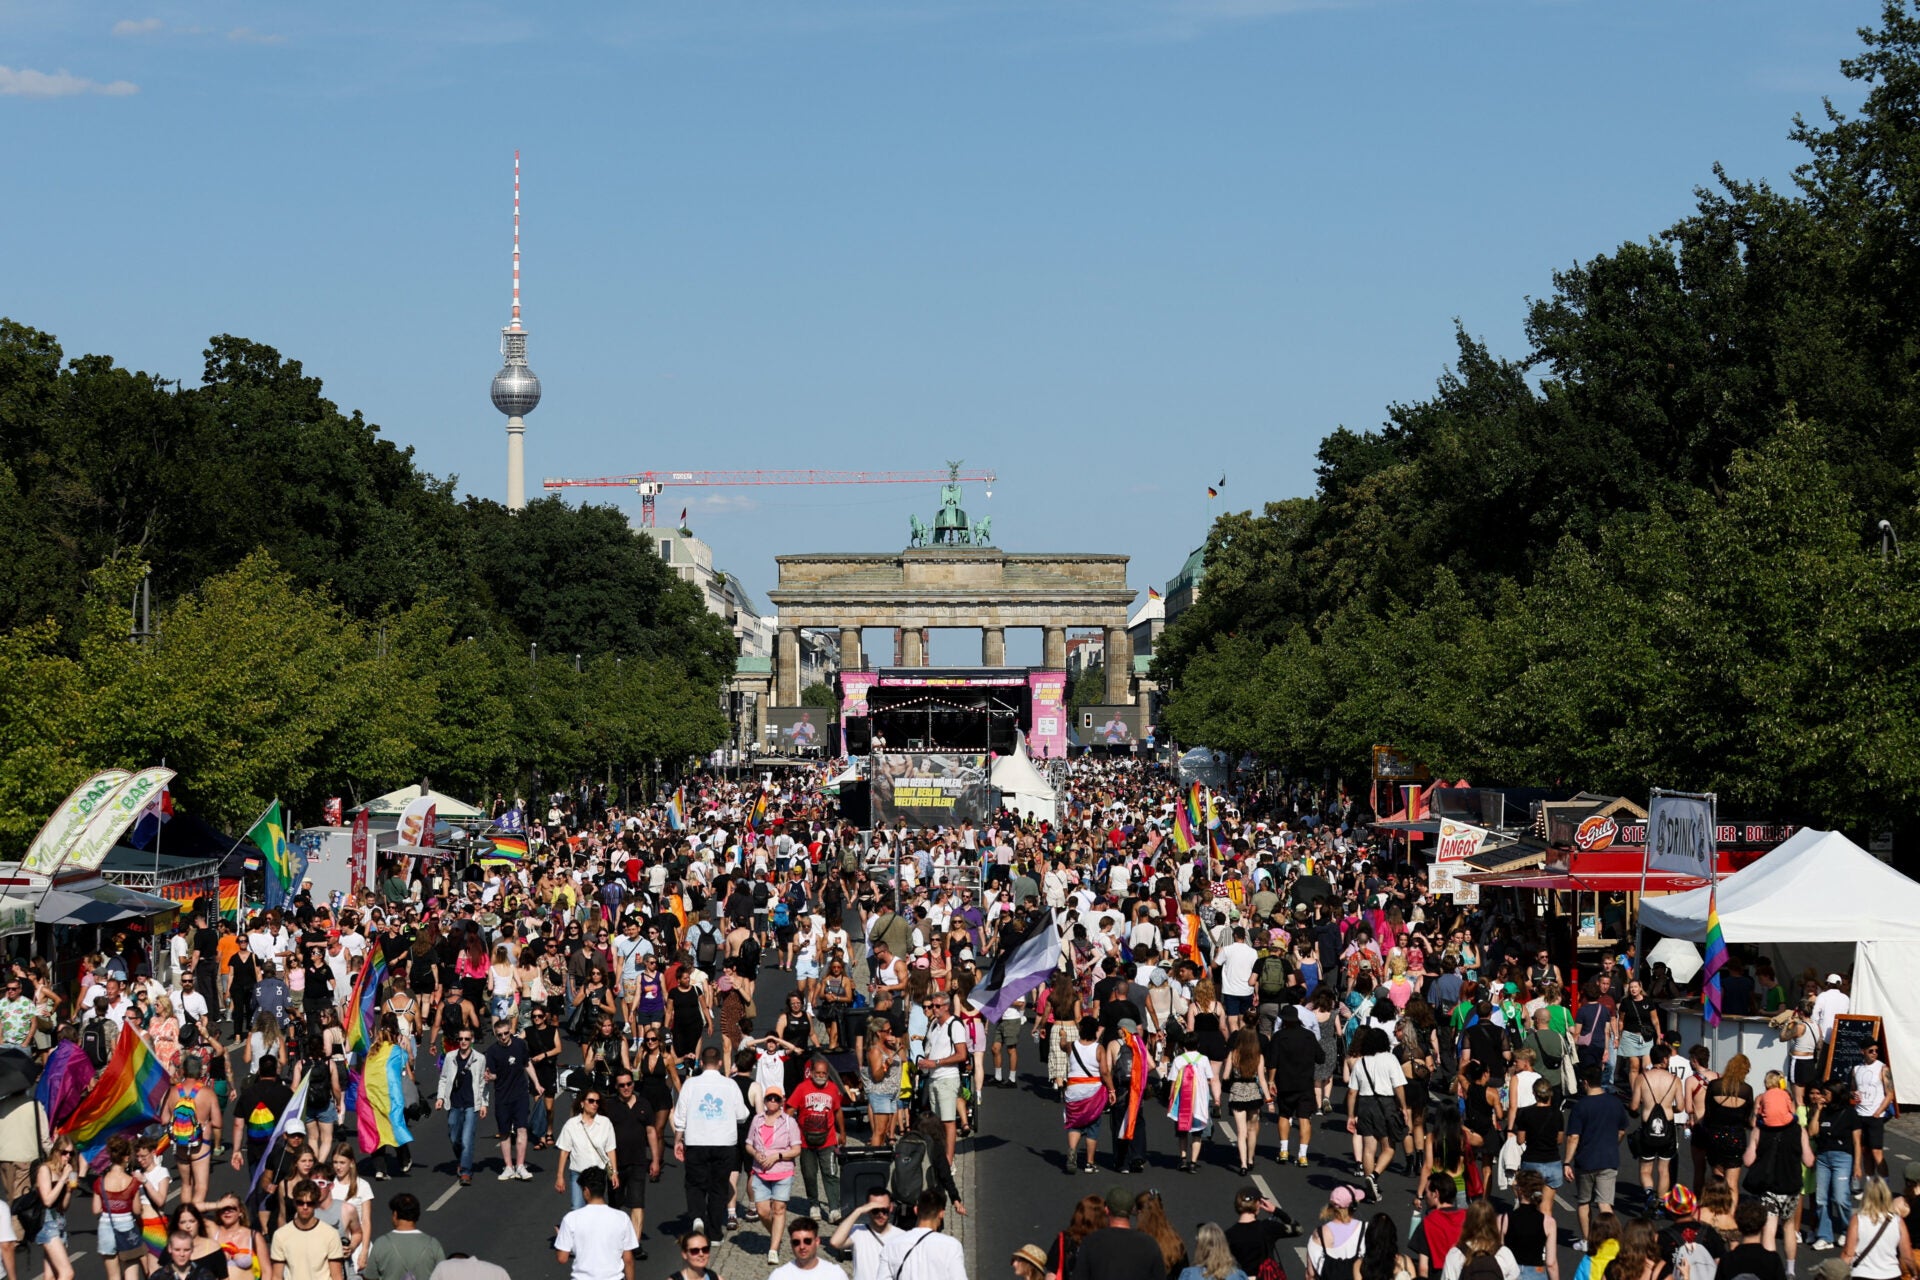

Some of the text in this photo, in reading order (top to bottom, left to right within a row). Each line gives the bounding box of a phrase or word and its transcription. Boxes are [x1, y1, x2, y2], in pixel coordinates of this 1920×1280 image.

[79, 780, 111, 815] BAR
[122, 778, 153, 809] BAR
[894, 797, 932, 807] WELTOFFEN
[917, 787, 941, 796] BERLIN
[1578, 817, 1614, 849] Grill
[1622, 826, 1646, 842] STE
[1667, 817, 1696, 858] DRINKS
[1670, 1066, 1686, 1080] 47
